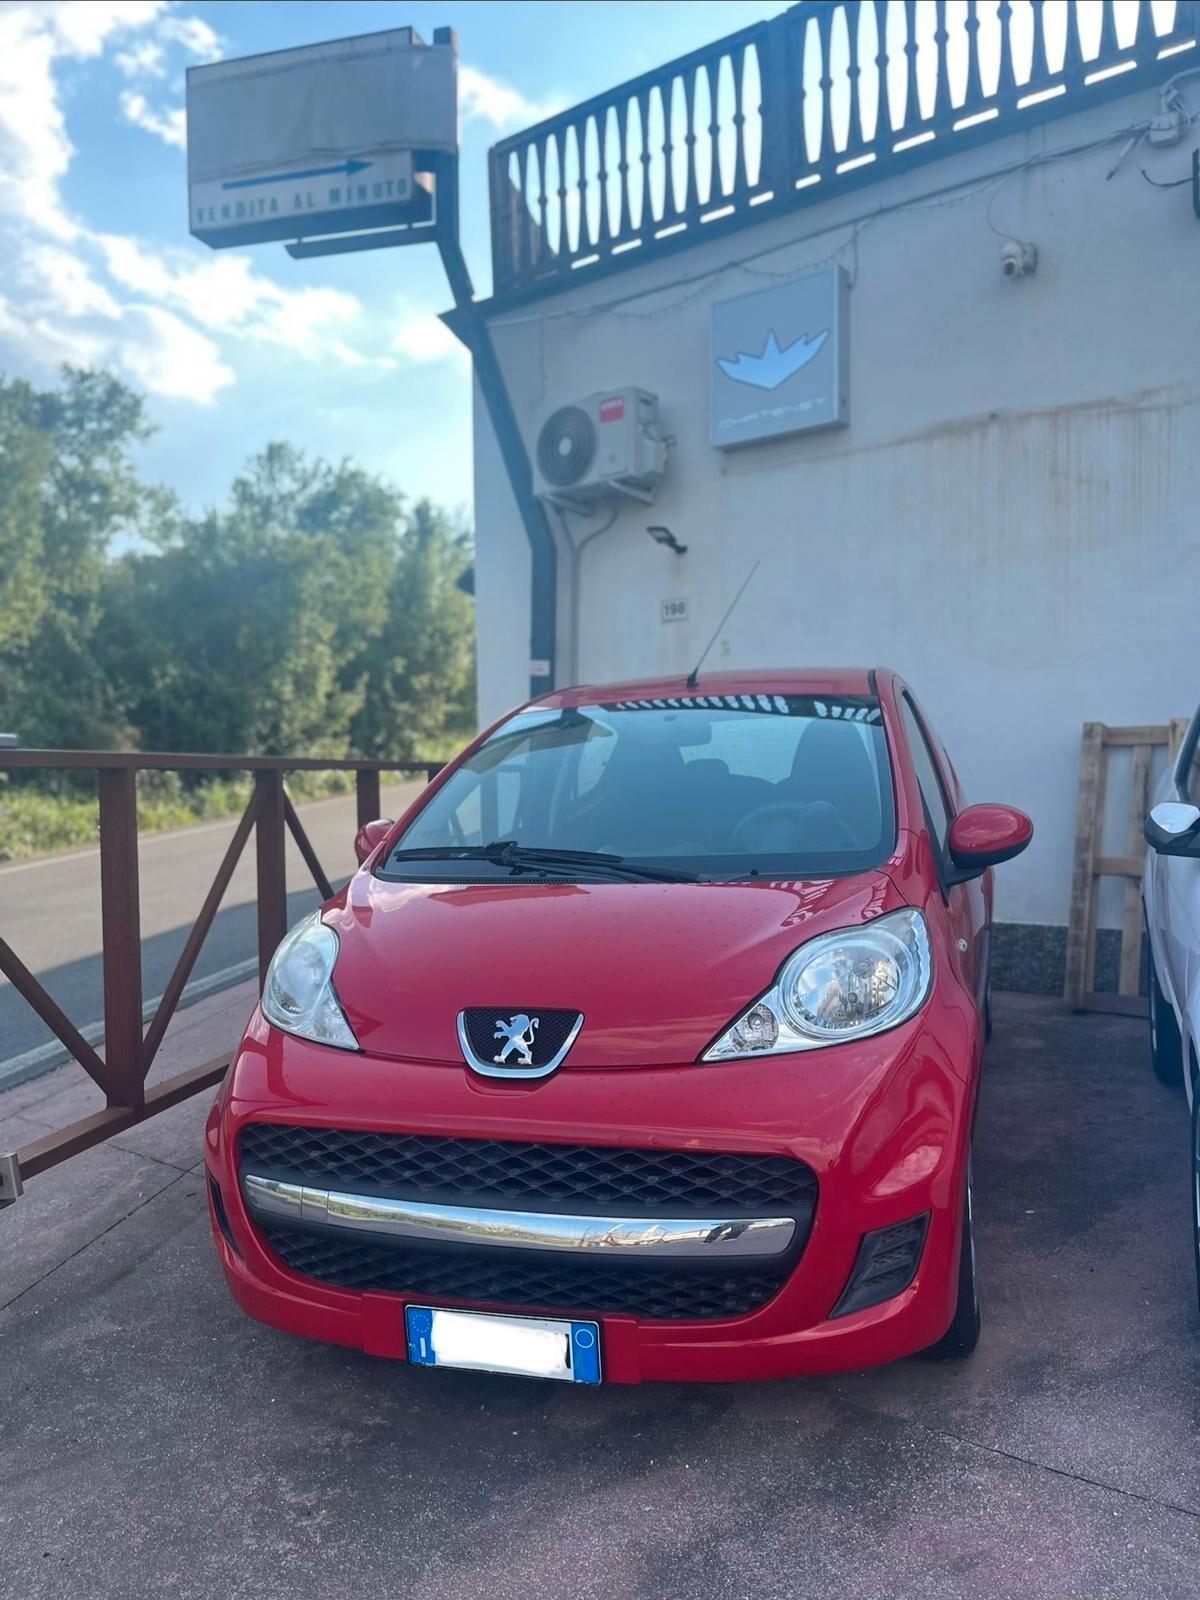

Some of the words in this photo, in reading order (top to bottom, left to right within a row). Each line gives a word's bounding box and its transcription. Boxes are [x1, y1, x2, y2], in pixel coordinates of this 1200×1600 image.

[196, 196, 278, 223] VENDITA
[293, 192, 315, 208] AL
[329, 178, 407, 205] MINUTO
[664, 602, 685, 616] 198
